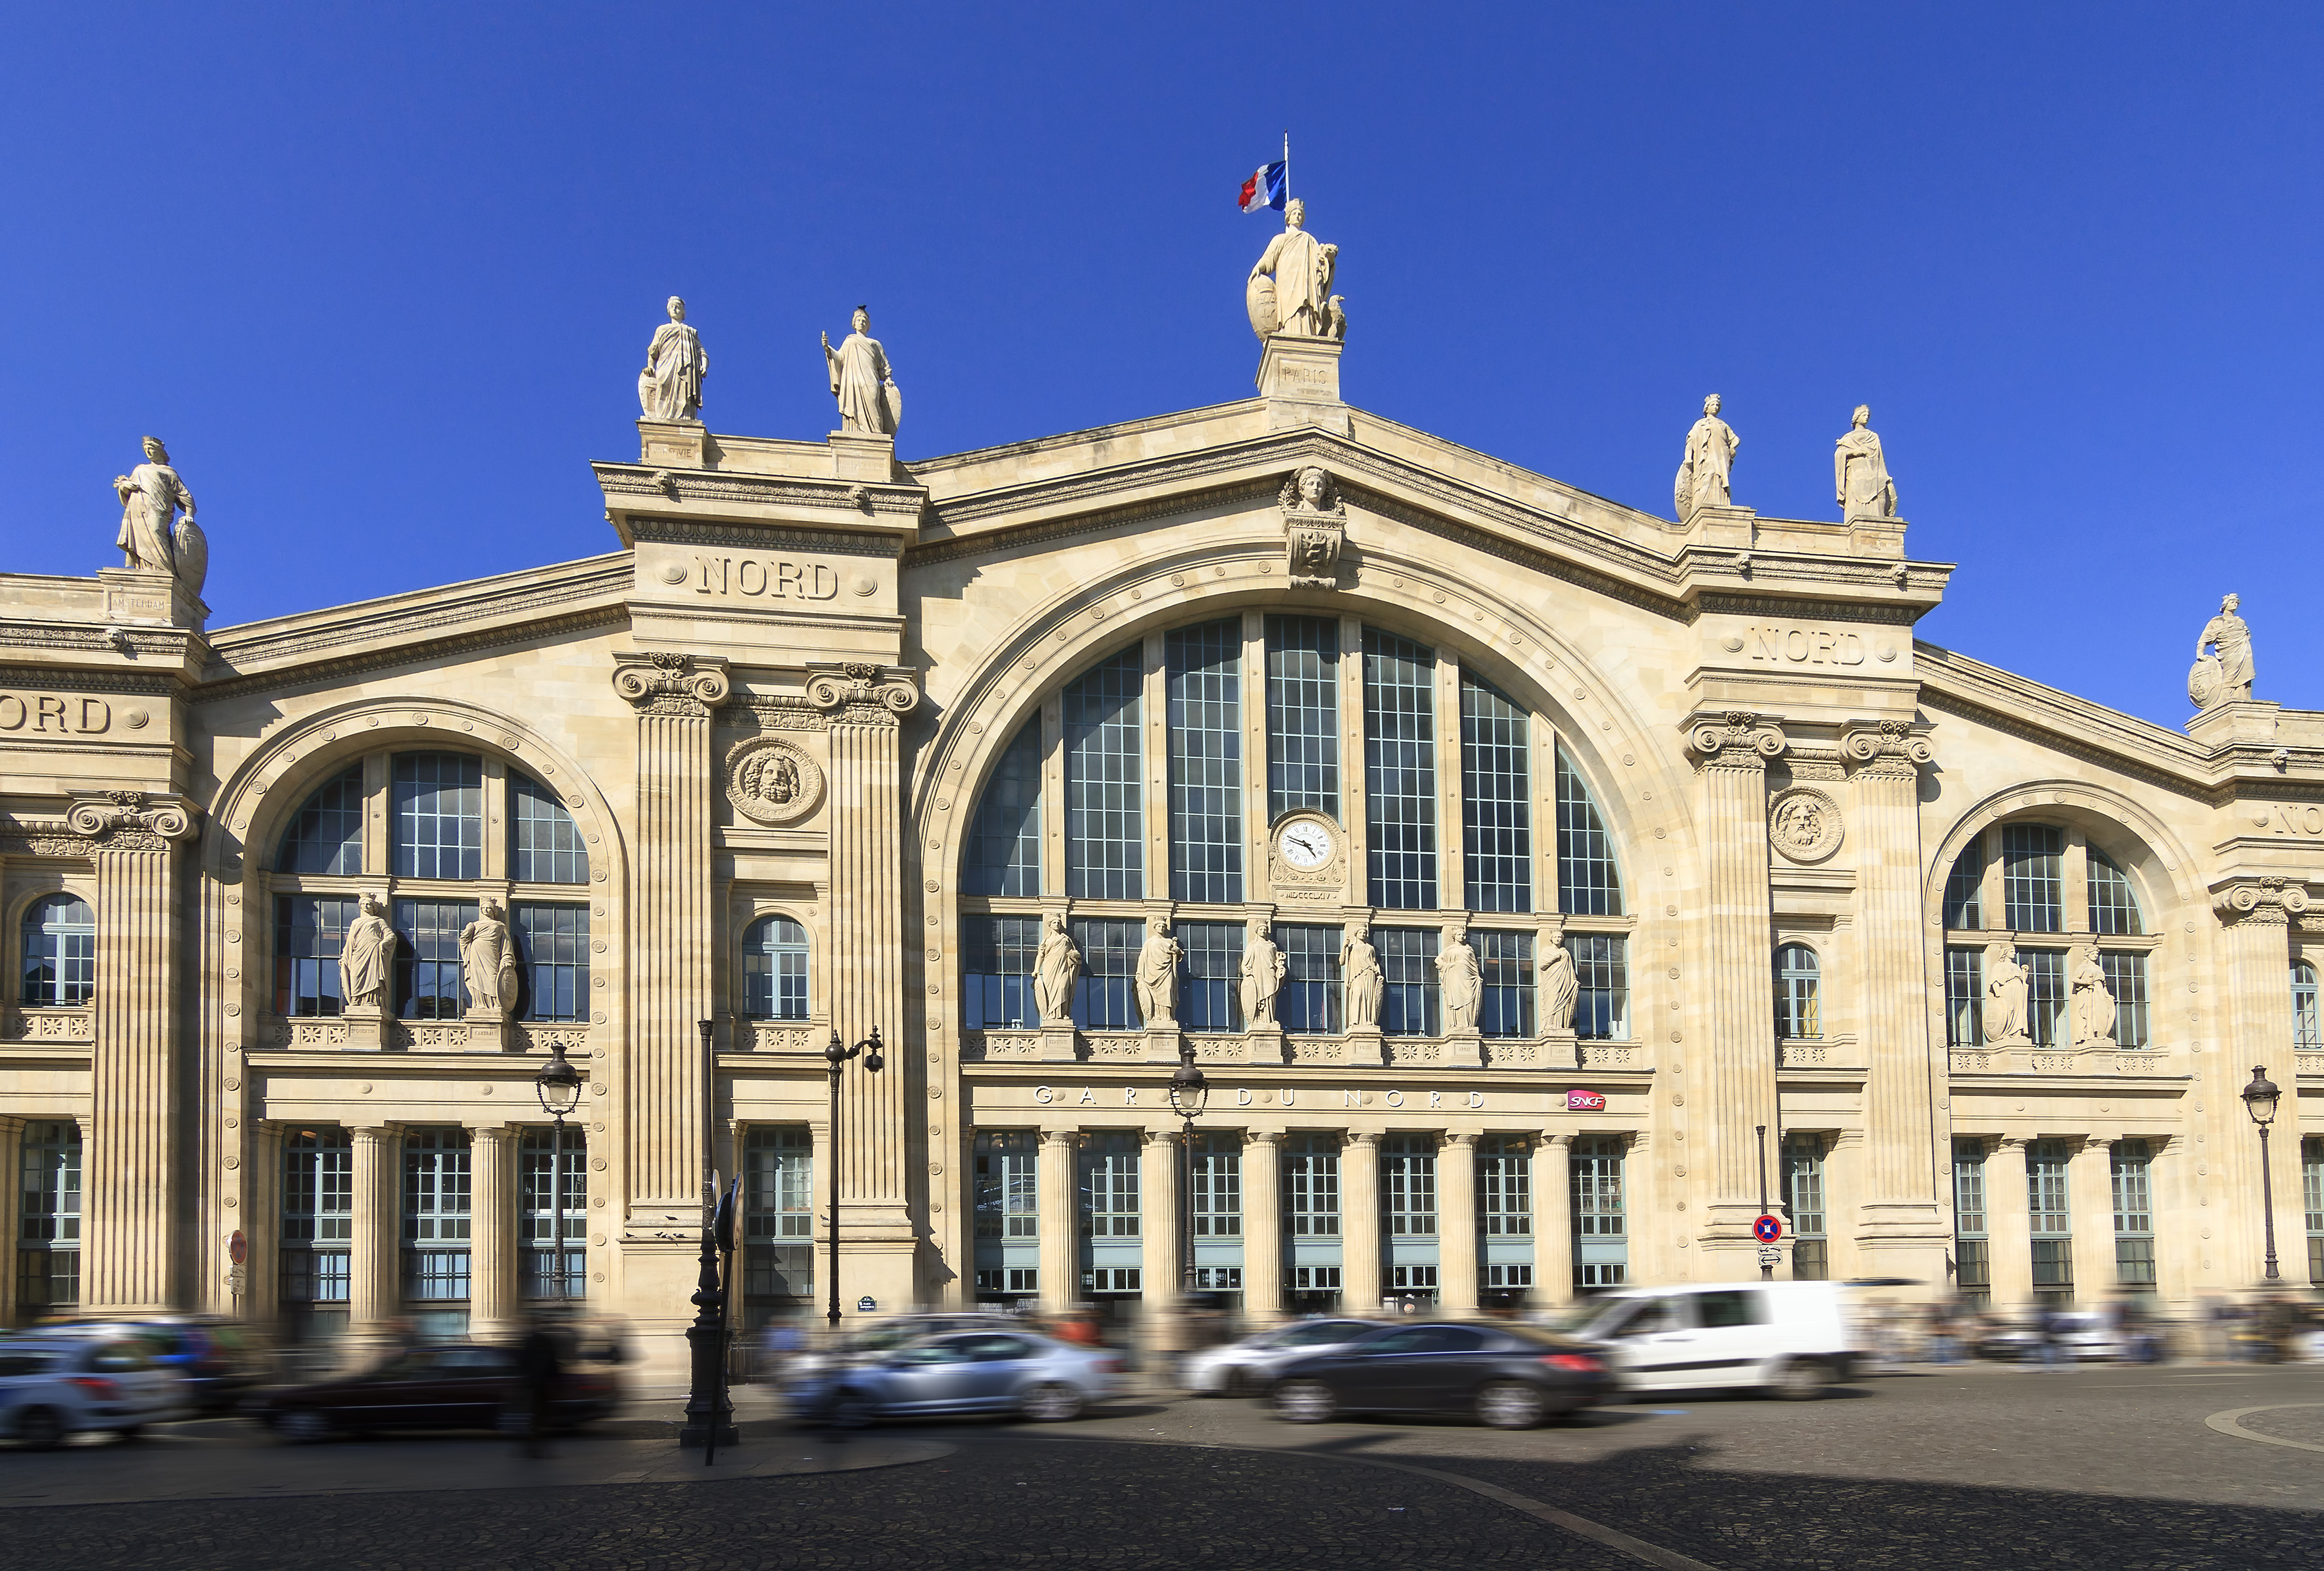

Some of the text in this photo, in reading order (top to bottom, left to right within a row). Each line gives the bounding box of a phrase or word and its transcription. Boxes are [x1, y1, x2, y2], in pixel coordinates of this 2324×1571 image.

[1284, 367, 1327, 384] PARIS
[695, 556, 839, 600] NORD
[112, 598, 164, 609] AMSTERDAM
[1751, 627, 1865, 666] NORD
[1237, 1087, 1294, 1106] DU
[1345, 1089, 1484, 1108] NORD
[1569, 1096, 1604, 1106] SNCF
